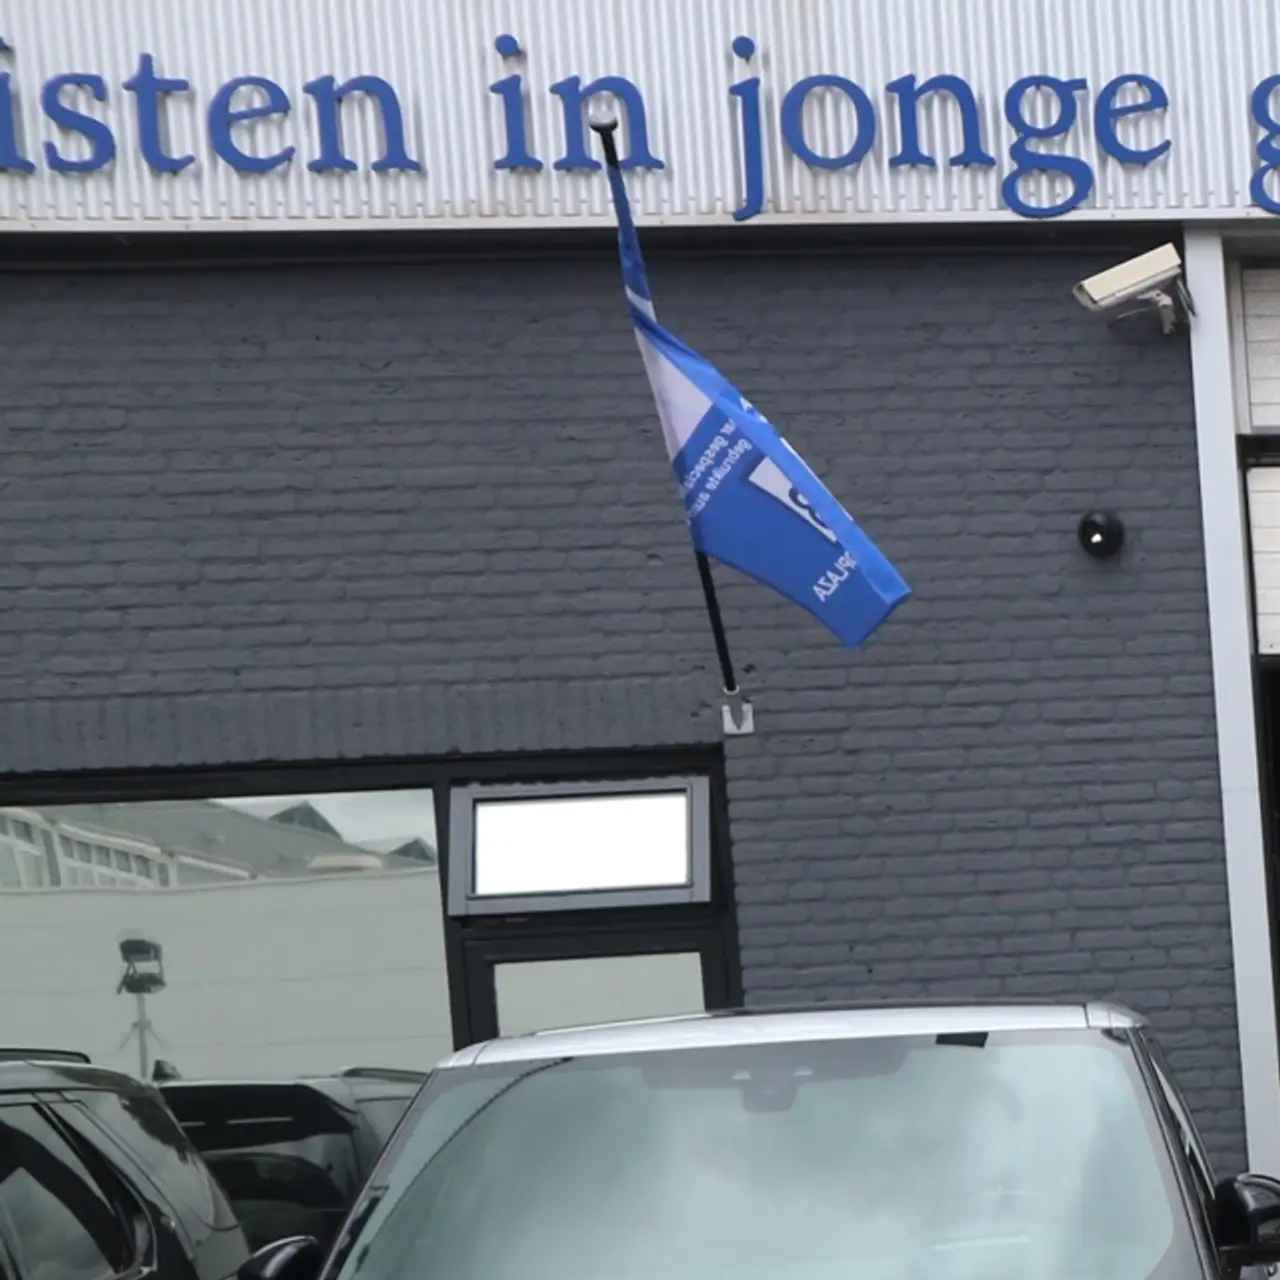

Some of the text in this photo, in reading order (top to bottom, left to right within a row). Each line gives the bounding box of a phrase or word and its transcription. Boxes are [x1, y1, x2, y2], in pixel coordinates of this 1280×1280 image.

[0, 36, 421, 175] isten
[491, 34, 665, 173] in
[729, 36, 1171, 221] jonge
